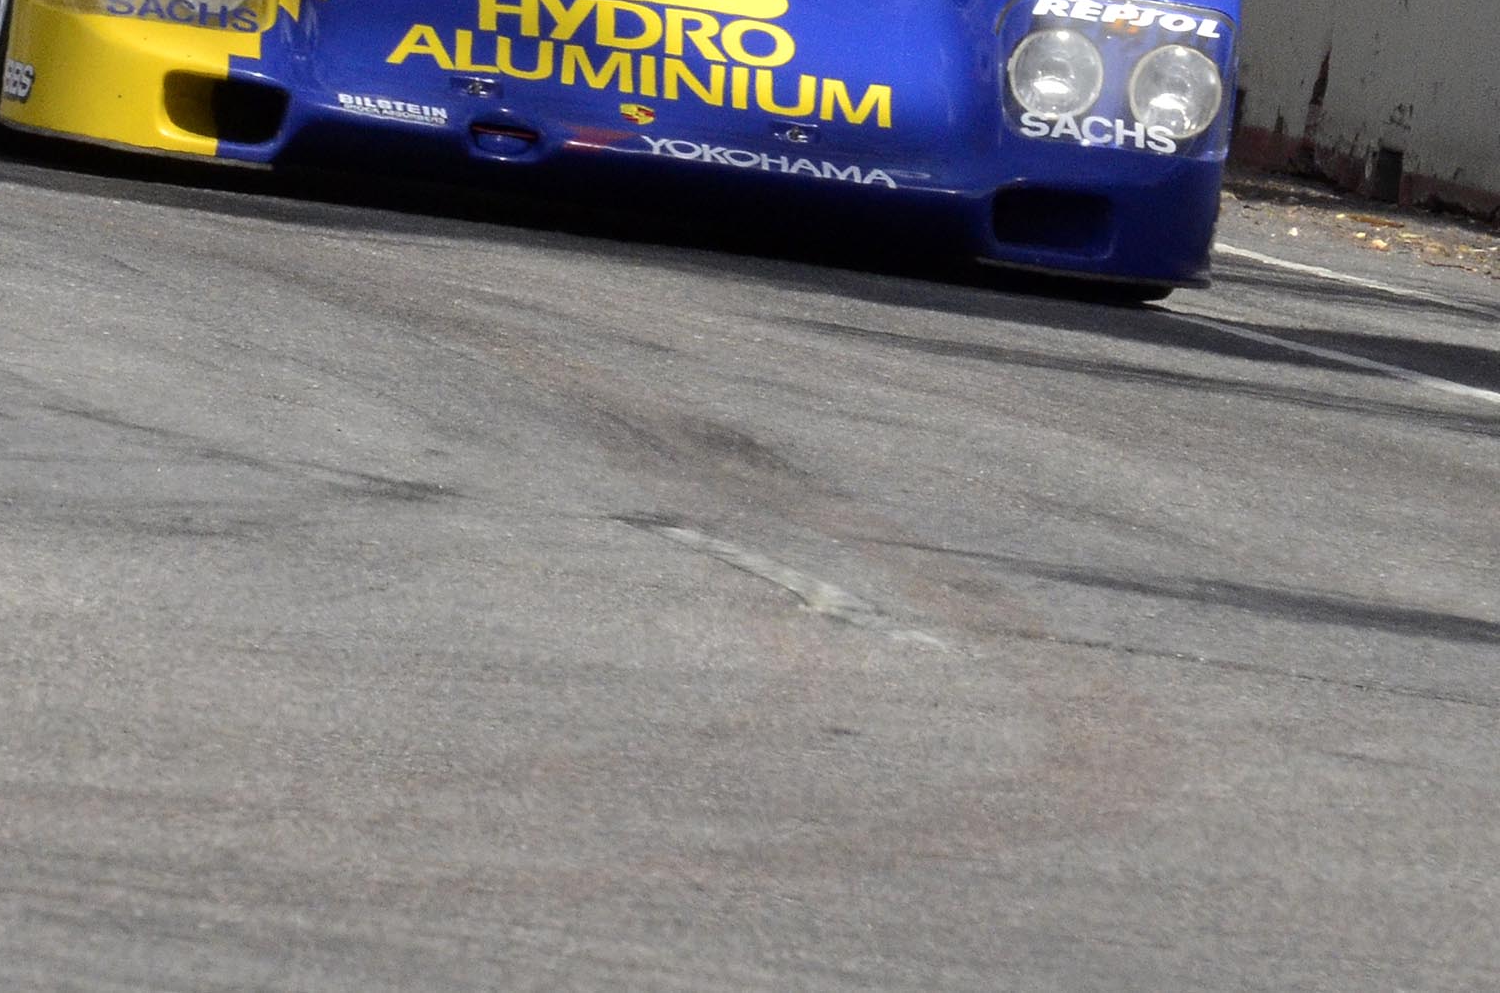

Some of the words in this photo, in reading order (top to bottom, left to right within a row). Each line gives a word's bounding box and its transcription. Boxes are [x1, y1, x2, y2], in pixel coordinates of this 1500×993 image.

[386, 24, 892, 128] ALUMINIUM
[338, 93, 448, 119] BILSTEIN
[1020, 111, 1177, 154] SACHS
[641, 135, 897, 189] YOKOHAMA
